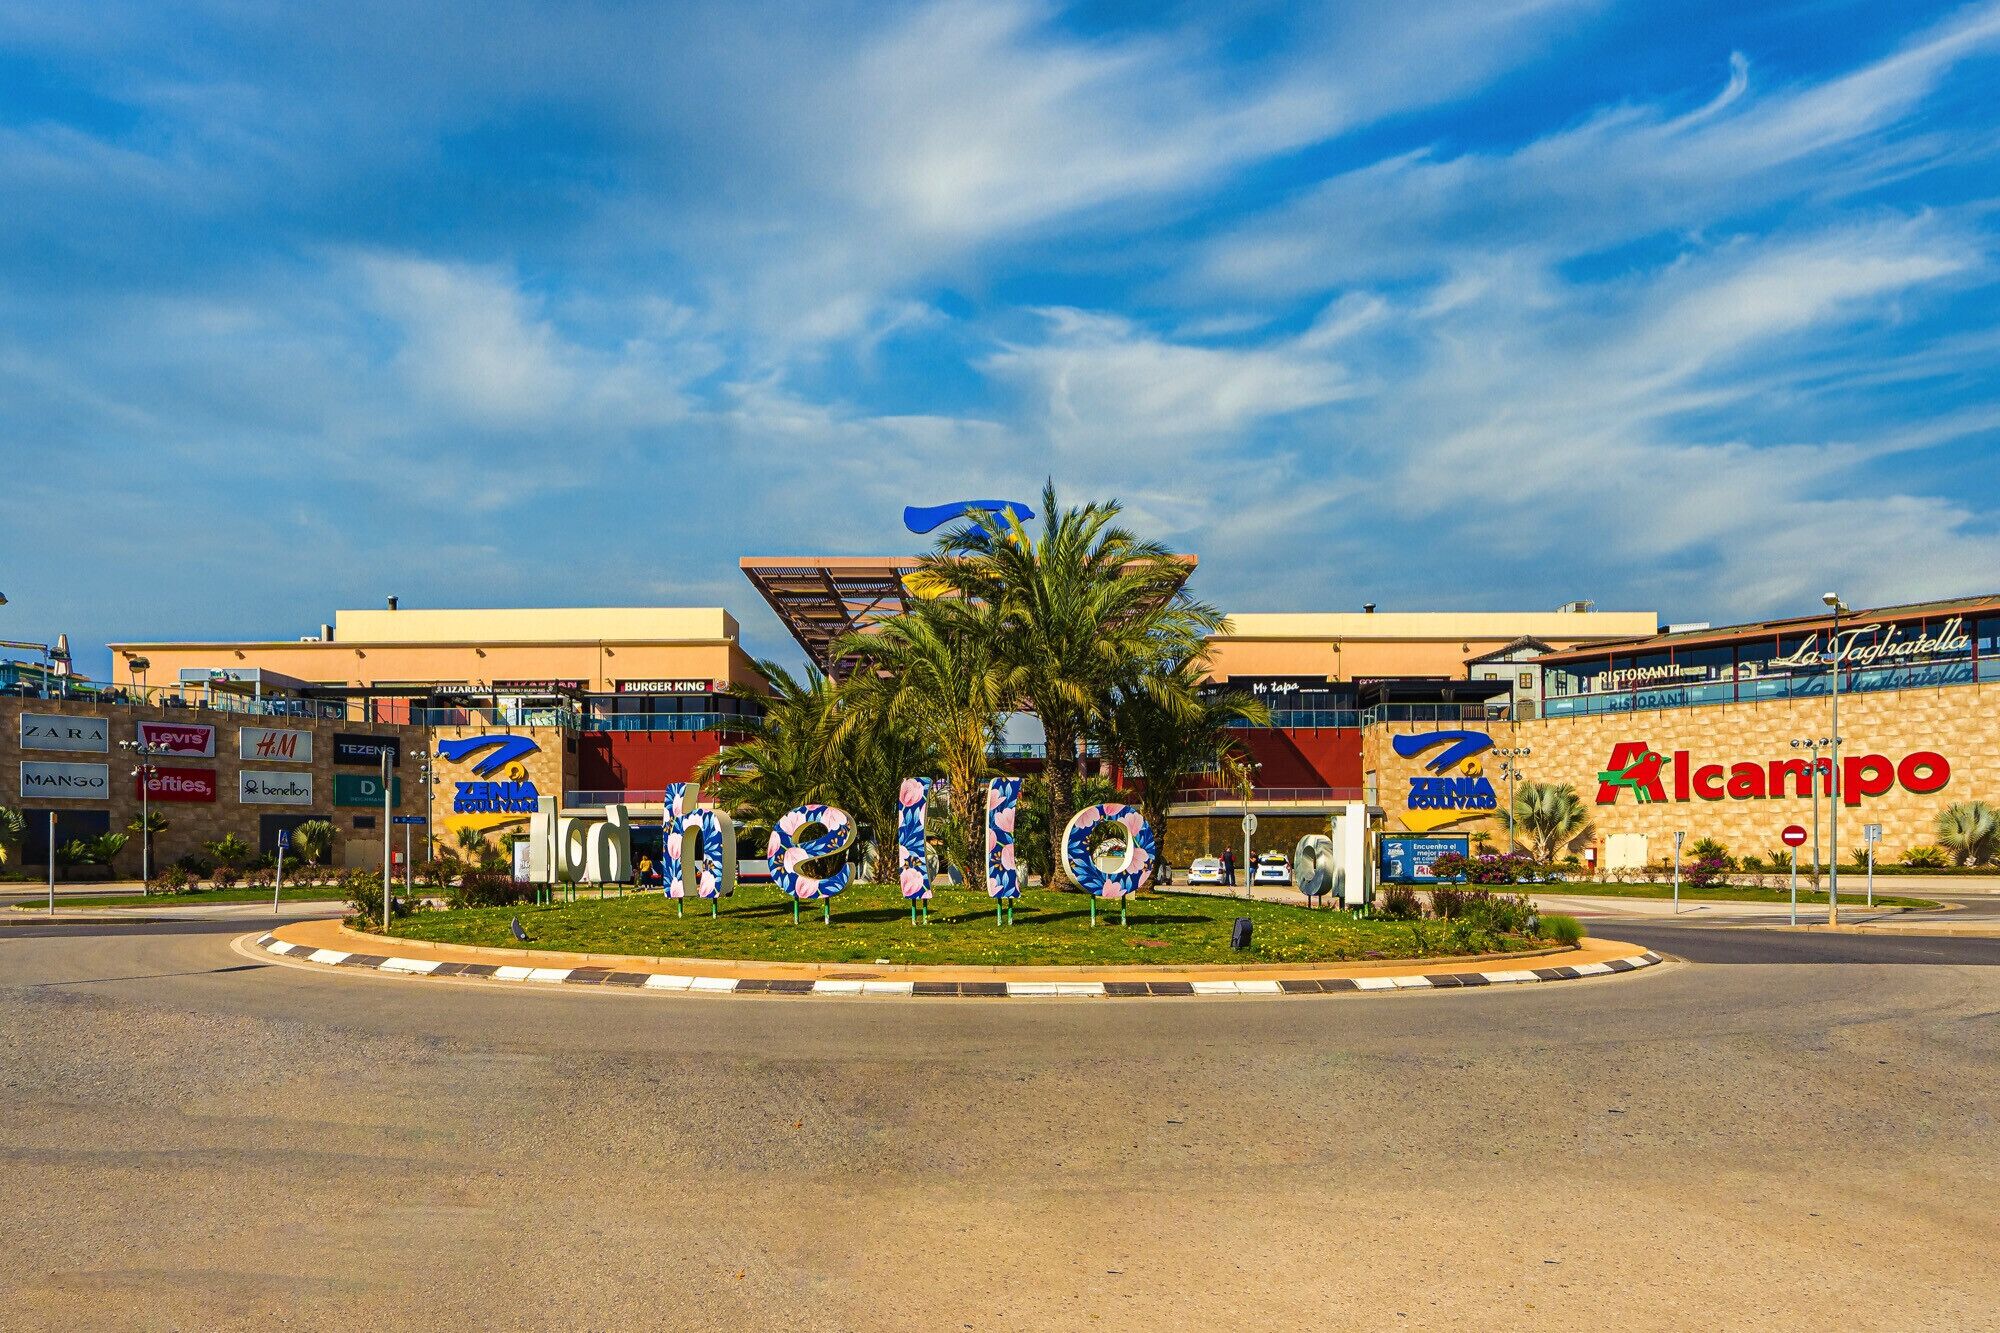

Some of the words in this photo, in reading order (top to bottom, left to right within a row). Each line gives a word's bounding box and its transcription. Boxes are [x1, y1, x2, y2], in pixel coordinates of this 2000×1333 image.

[1777, 633, 1820, 666] La
[1821, 617, 1970, 665] Tagliatella
[1599, 664, 1680, 683] RISTORANTI
[443, 685, 492, 694] LIZARRAN
[624, 681, 672, 692] BURGER
[674, 681, 705, 692] KING
[1253, 682, 1267, 695] My
[1270, 681, 1299, 695] tapa
[24, 726, 105, 741] ZARA
[256, 731, 298, 759] H&M
[340, 744, 395, 756] TEZENIS
[25, 773, 104, 788] MANGO
[1596, 741, 1951, 807] Alcampo
[148, 775, 212, 795] efties,
[262, 780, 309, 797] benetton
[360, 780, 376, 796] D
[455, 781, 540, 800] ZENIA
[1408, 777, 1496, 797] ZENIA
[662, 777, 1157, 899] hello
[1416, 850, 1437, 858] mejor
